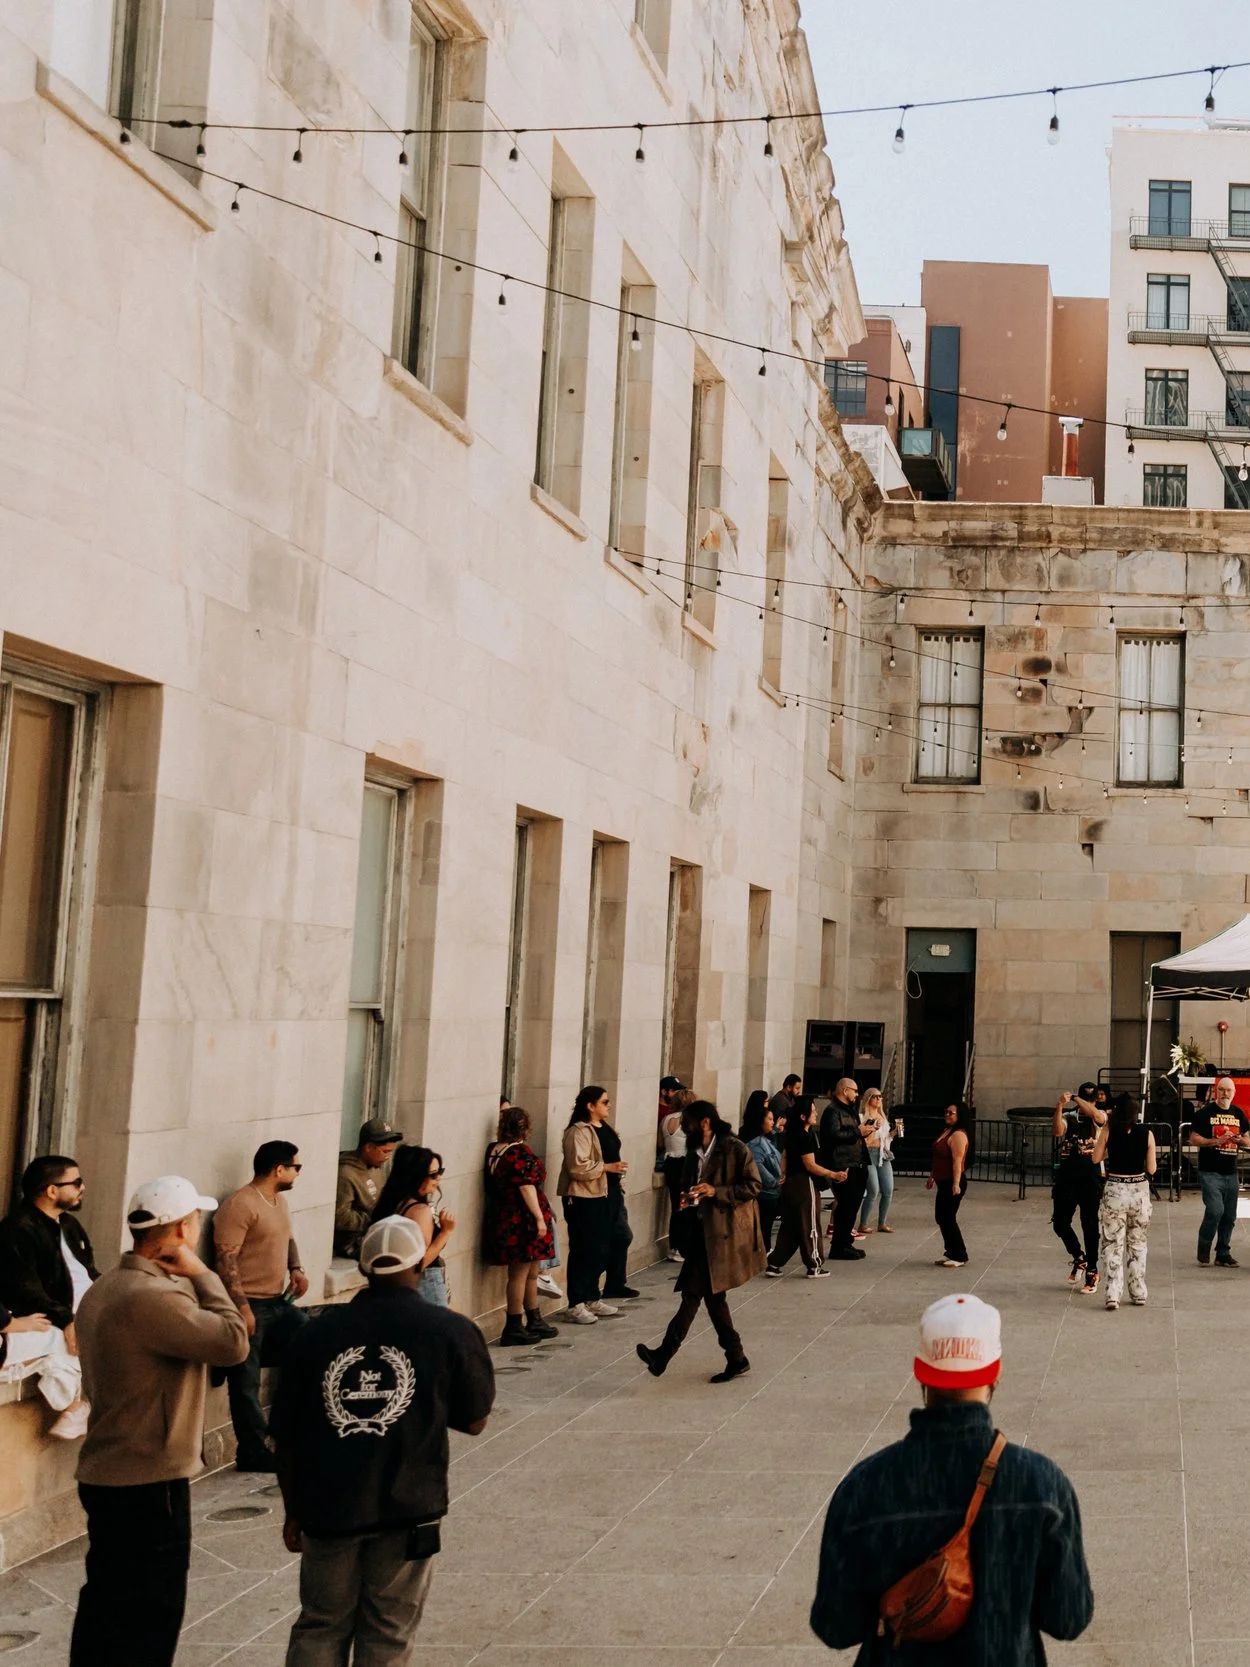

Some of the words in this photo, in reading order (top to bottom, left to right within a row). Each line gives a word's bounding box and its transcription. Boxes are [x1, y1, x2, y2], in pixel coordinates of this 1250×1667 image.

[359, 1370, 382, 1382] Not
[360, 1381, 378, 1392] for
[341, 1389, 395, 1401] Ceremony
